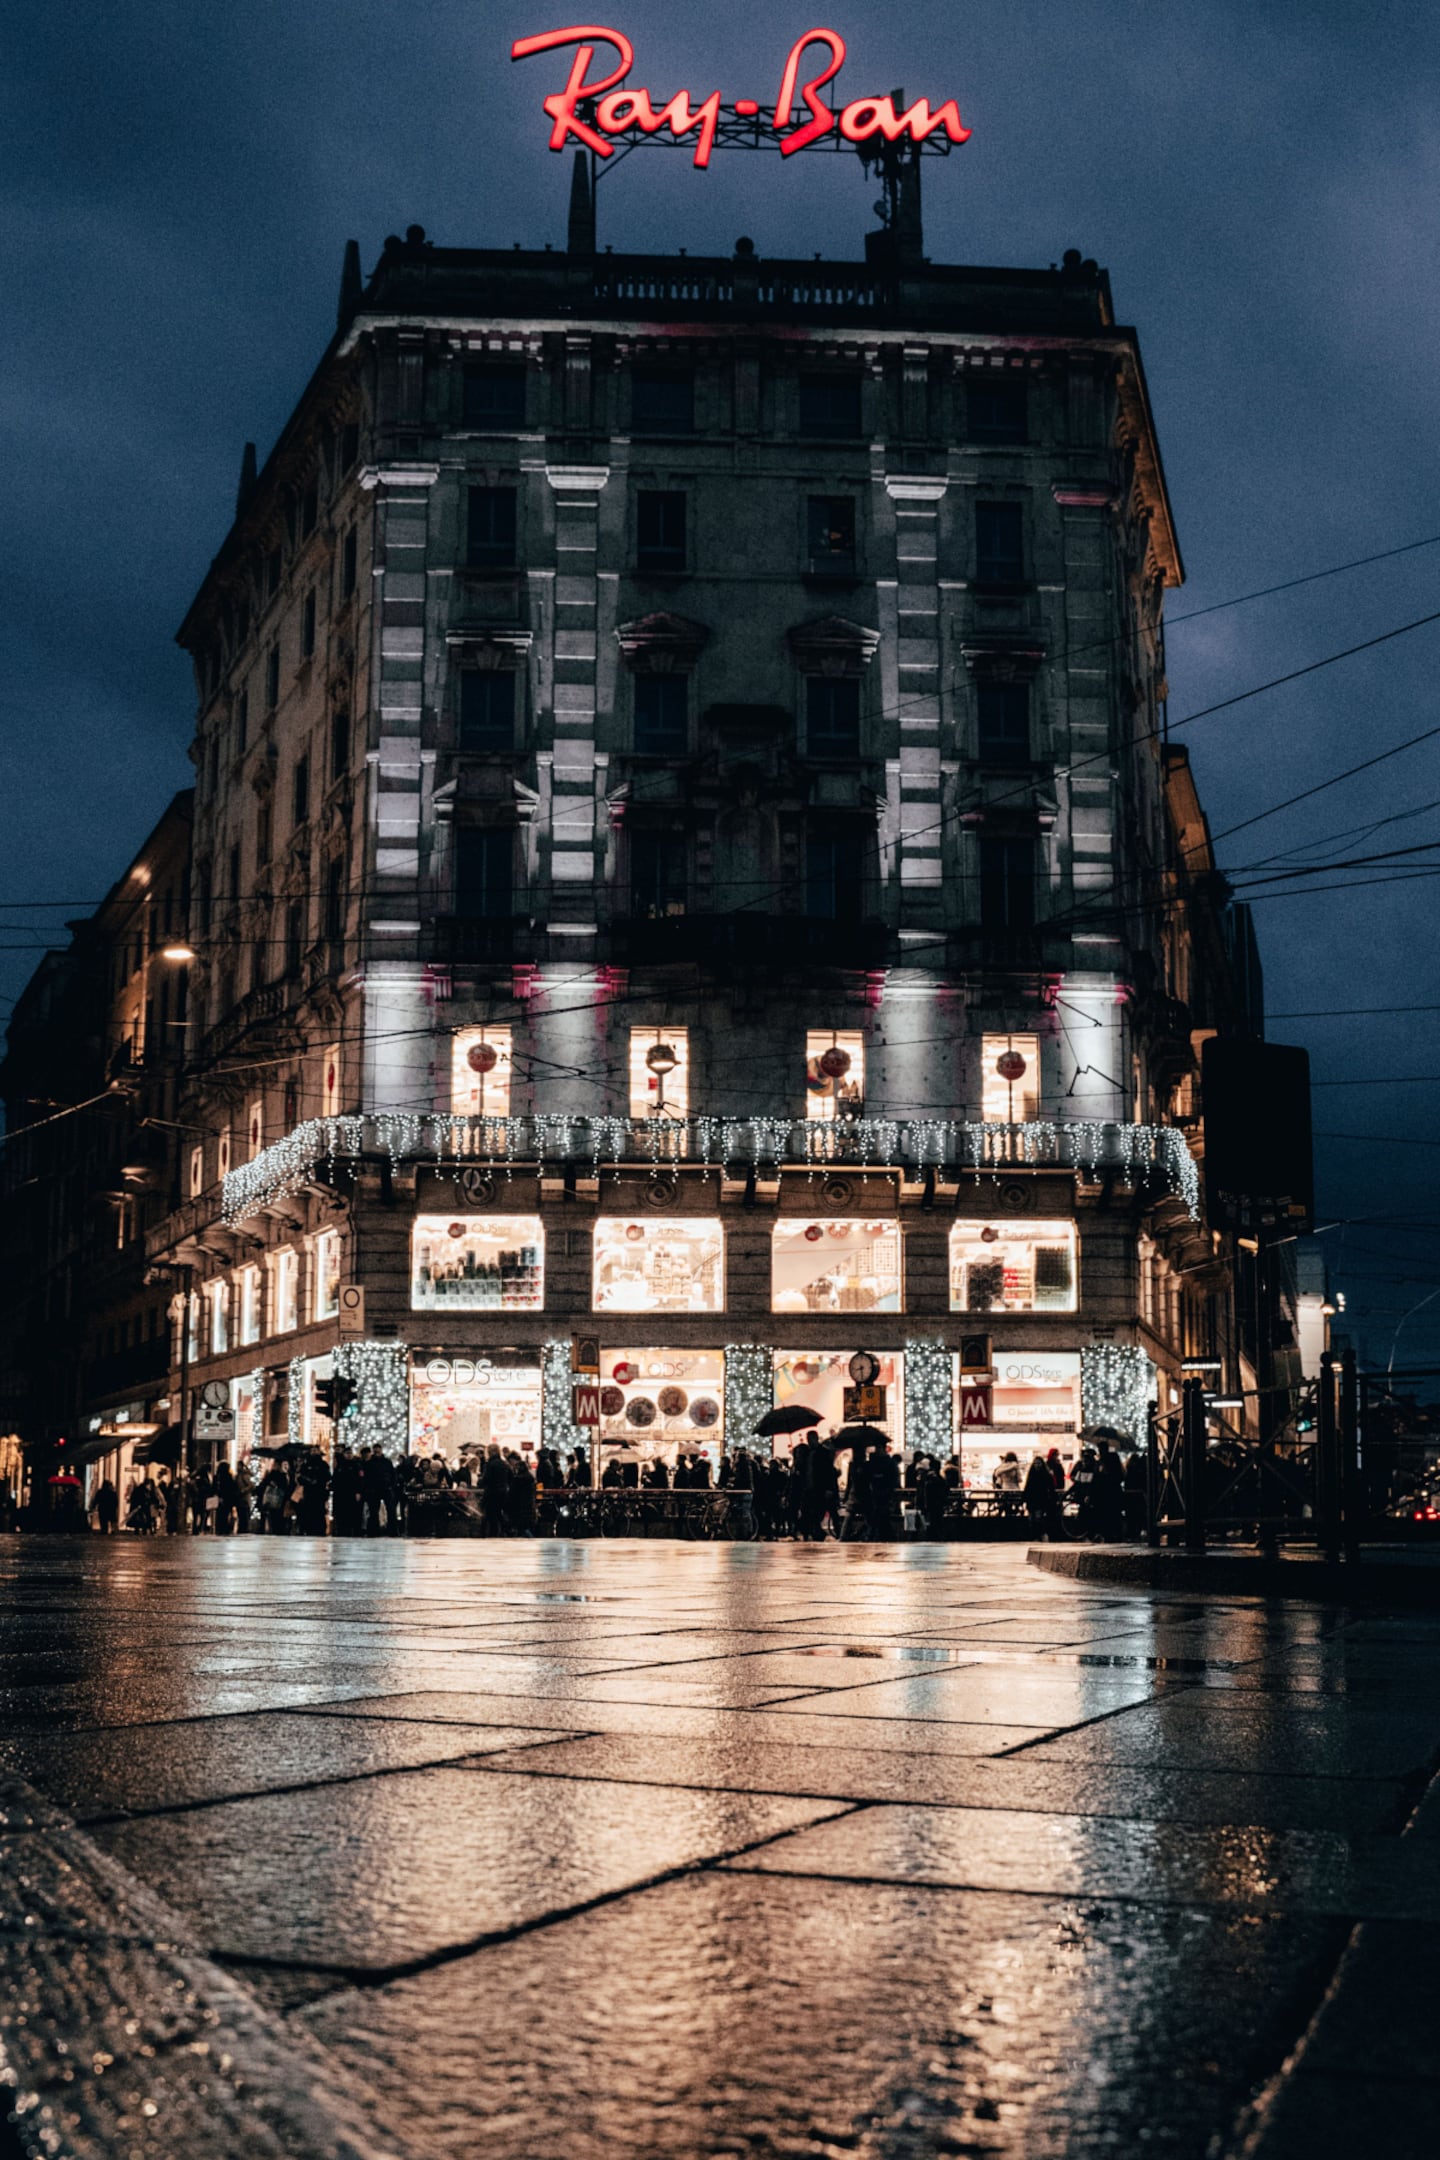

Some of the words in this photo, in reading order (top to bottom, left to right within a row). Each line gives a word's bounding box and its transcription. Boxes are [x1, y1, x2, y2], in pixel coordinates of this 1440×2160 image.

[511, 26, 972, 168] Ray-Ban
[579, 1395, 598, 1418] M
[963, 1396, 987, 1418] M
